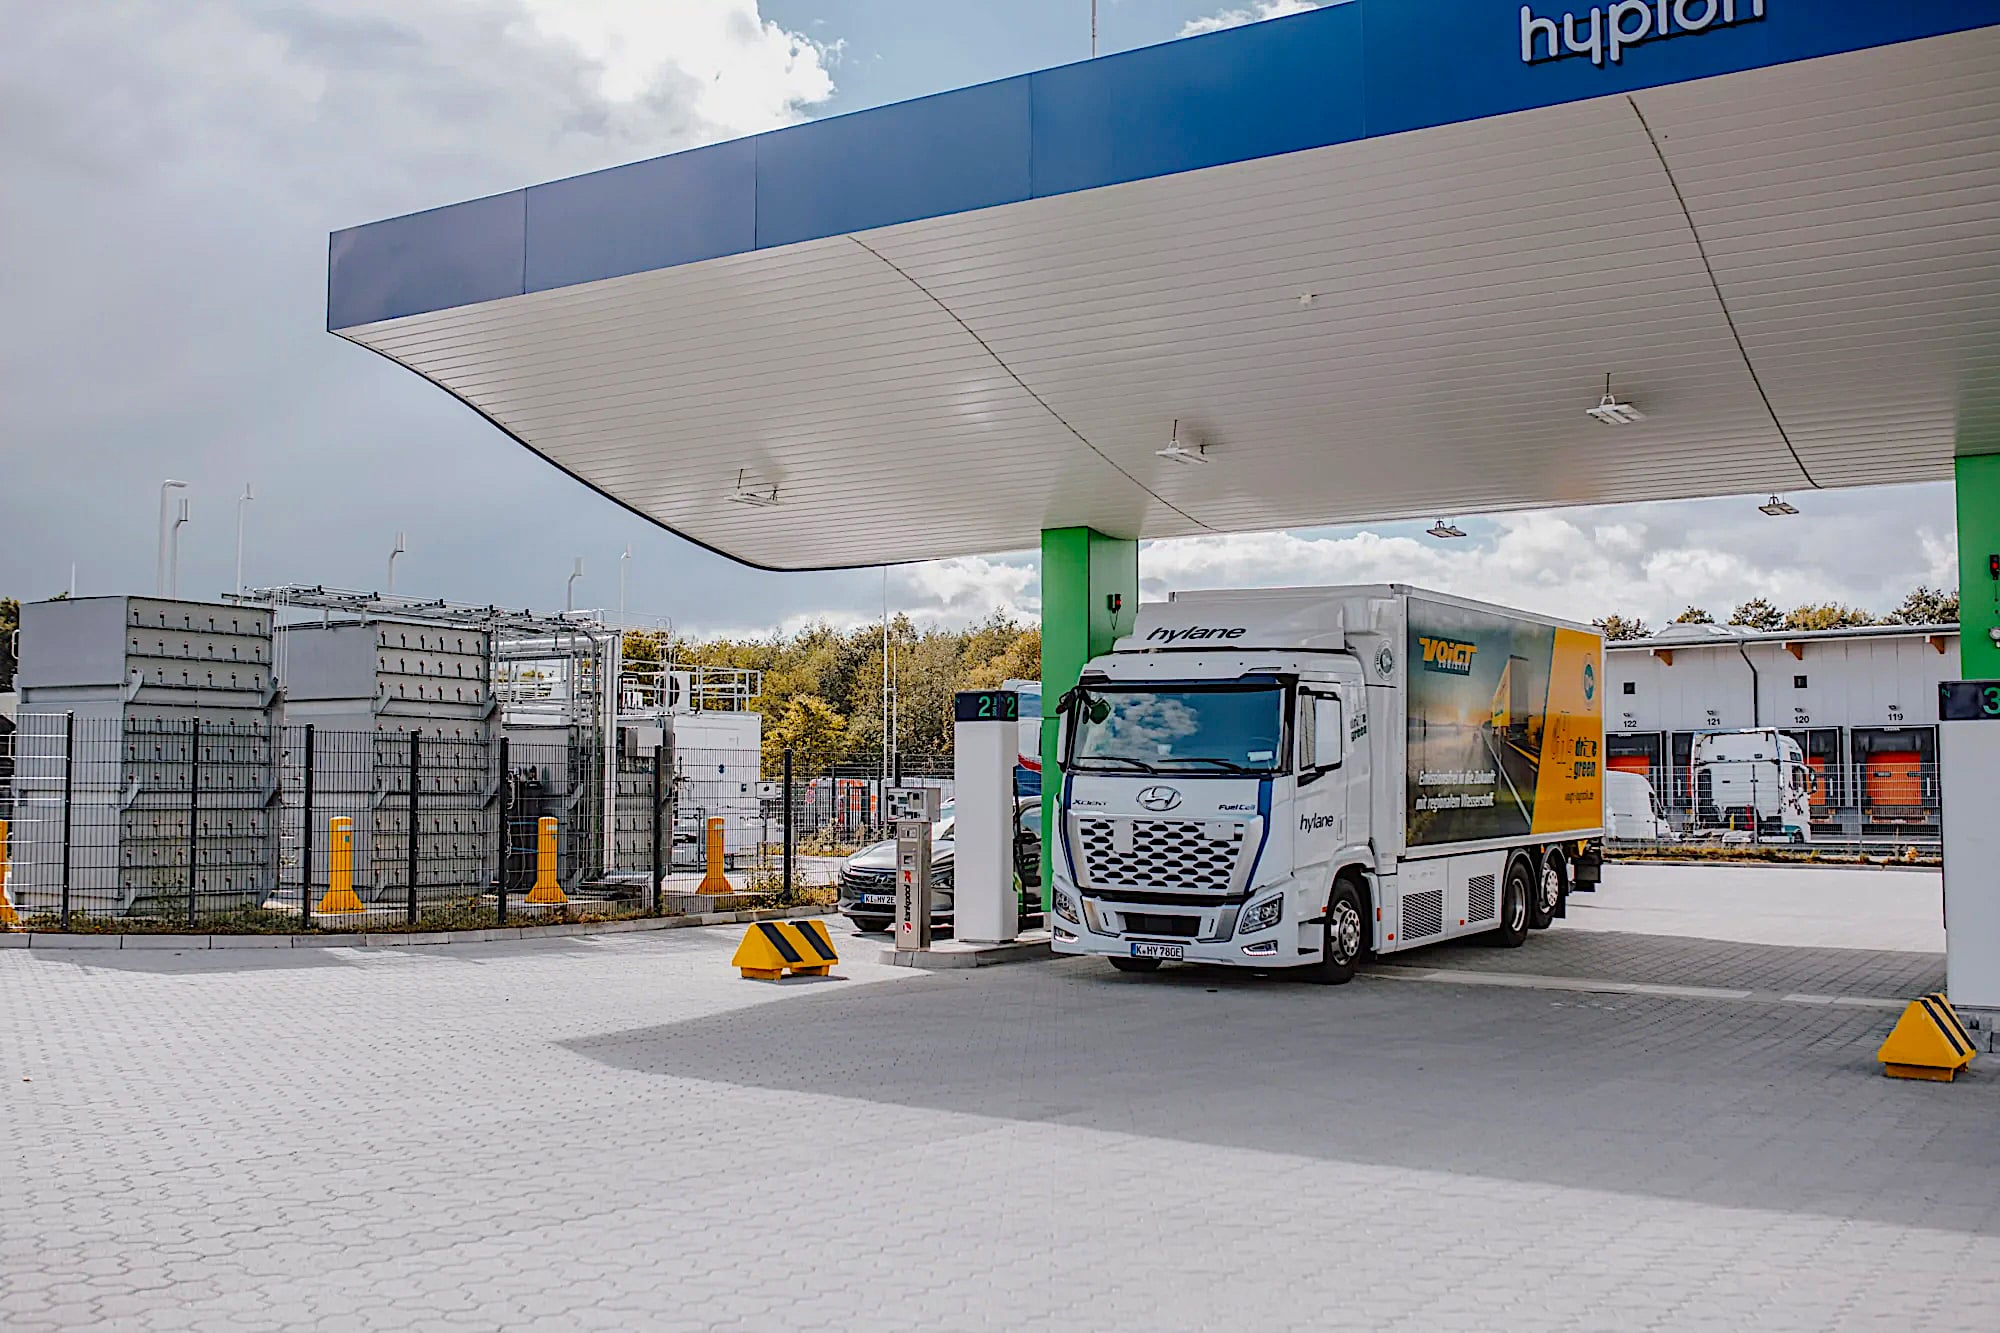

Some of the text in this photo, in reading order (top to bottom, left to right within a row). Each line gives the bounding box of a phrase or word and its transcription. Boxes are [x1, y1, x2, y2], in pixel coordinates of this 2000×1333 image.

[1146, 626, 1246, 644] hylane
[978, 695, 991, 717] 2
[1006, 696, 1016, 718] 2
[1983, 686, 2000, 715] 3
[1623, 720, 1637, 728] 122
[1706, 718, 1721, 726] 121
[1794, 715, 1810, 724] 120
[1887, 713, 1904, 721] 119
[1300, 812, 1334, 834] hylane
